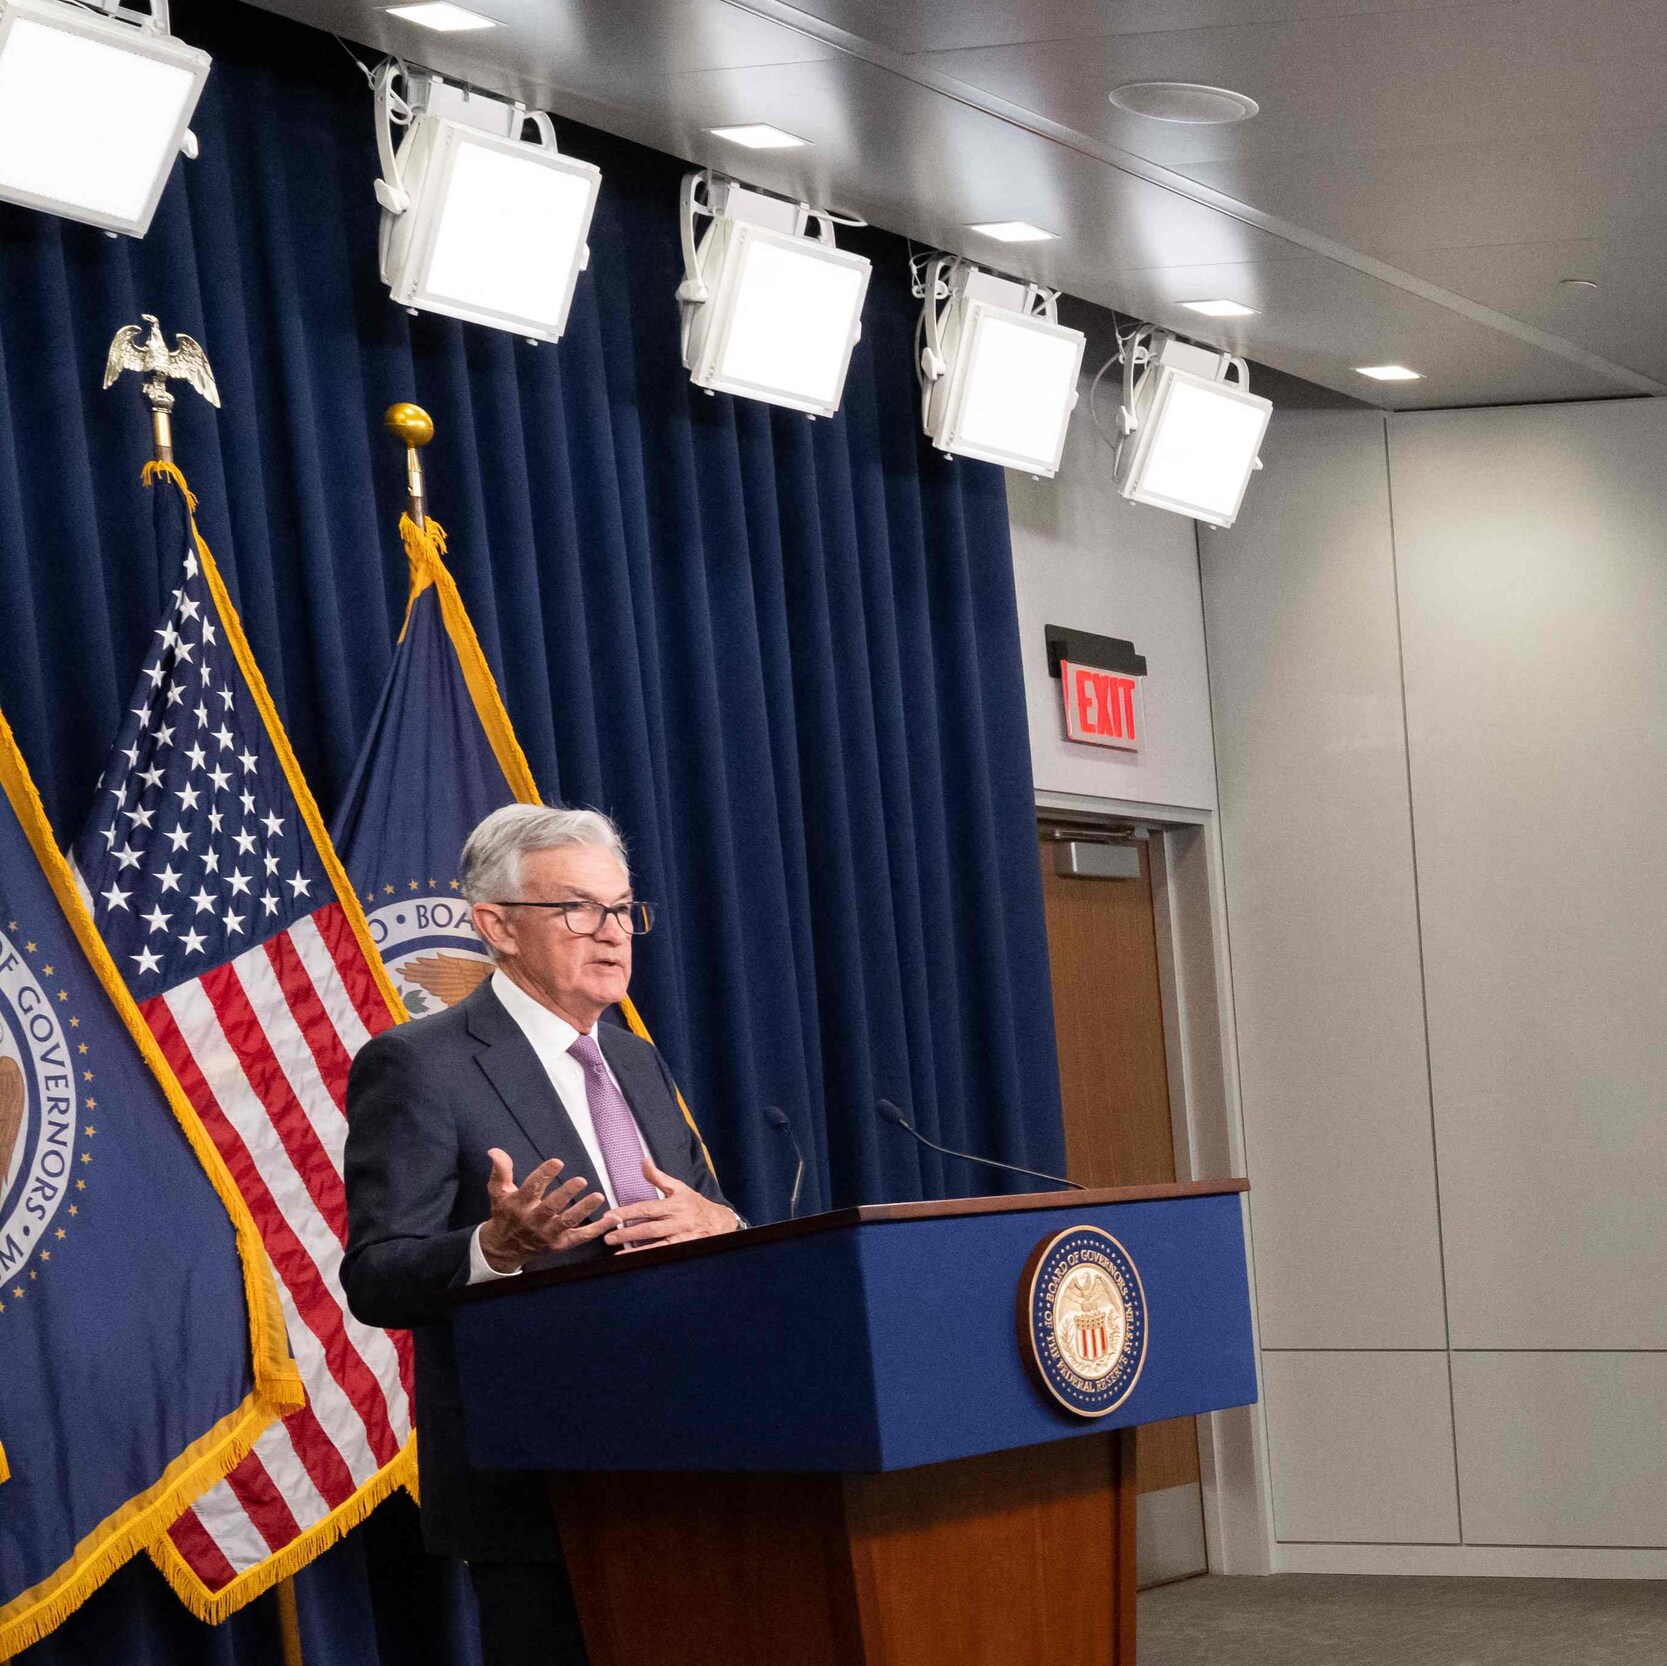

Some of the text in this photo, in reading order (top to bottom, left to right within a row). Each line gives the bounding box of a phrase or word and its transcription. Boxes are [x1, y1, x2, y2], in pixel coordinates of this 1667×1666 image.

[1075, 670, 1136, 740] EXIT
[416, 903, 475, 932] BOA
[17, 985, 70, 1222] GOVERNORS
[1045, 1249, 1128, 1303] BOARD OF GOVERNORS
[1046, 1332, 1060, 1362] THE
[1055, 1357, 1095, 1393] FEDERAL
[1095, 1355, 1128, 1393] RESERVE
[1124, 1302, 1133, 1355] SYSTEM
